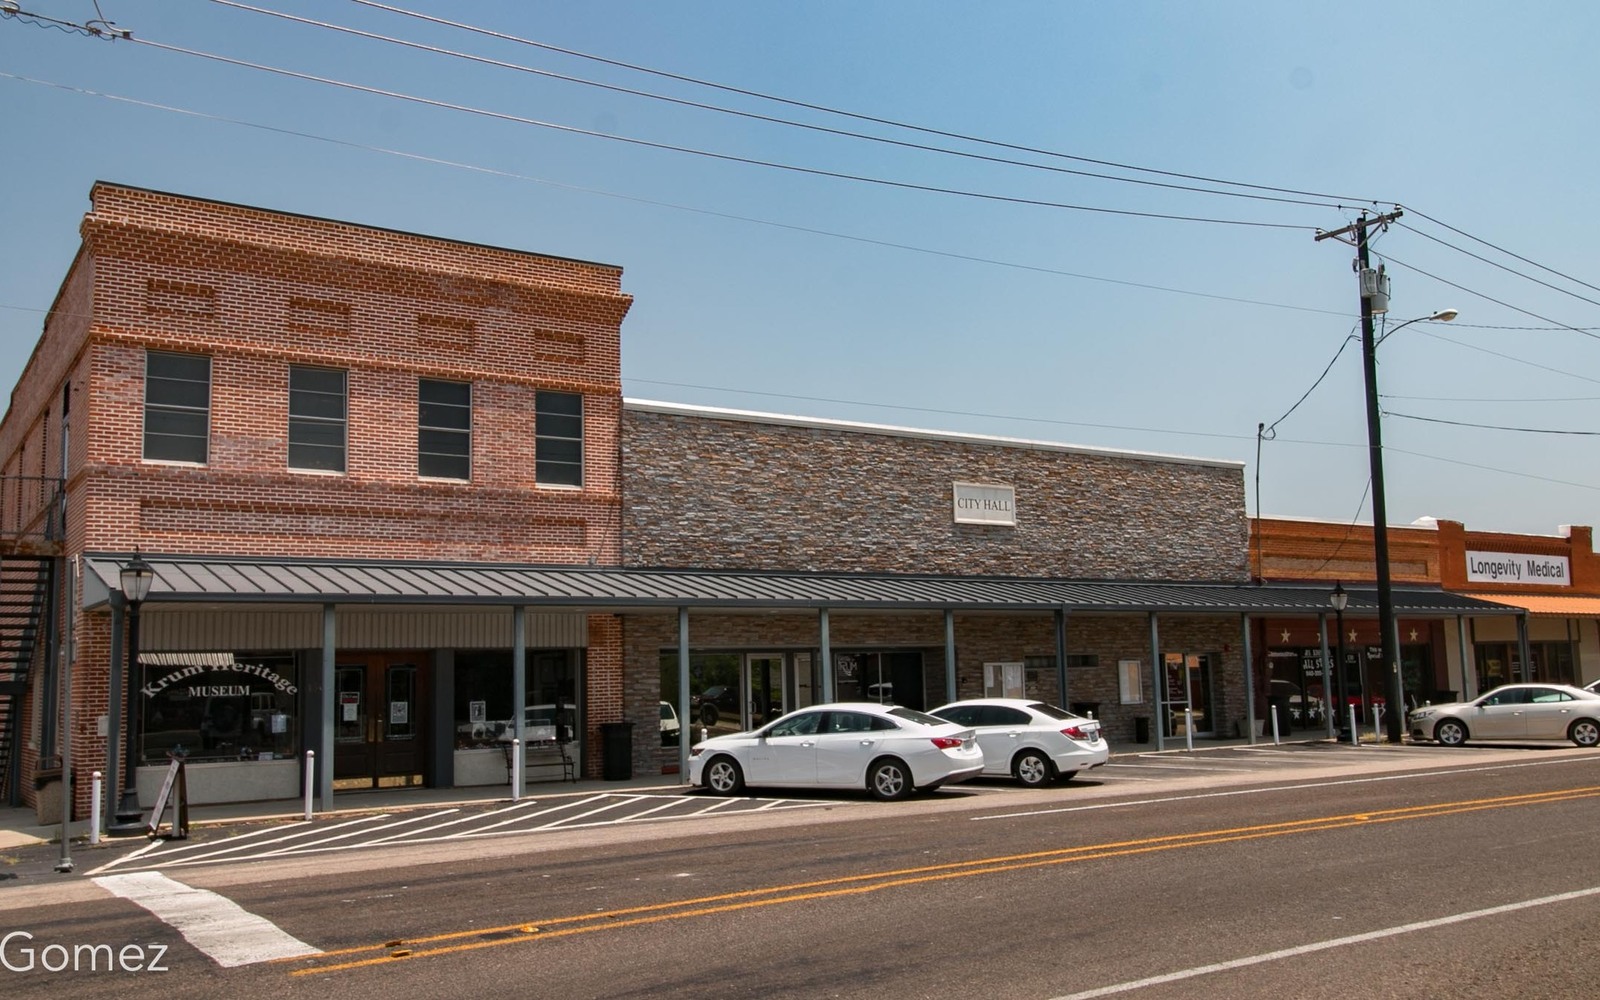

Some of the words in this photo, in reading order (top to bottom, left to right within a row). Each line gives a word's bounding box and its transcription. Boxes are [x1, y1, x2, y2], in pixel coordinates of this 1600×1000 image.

[957, 498, 979, 509] CITY
[984, 500, 1010, 511] HALL
[1470, 557, 1521, 580] Longevity
[1527, 560, 1564, 577] Medical
[140, 664, 204, 698] Krum
[188, 685, 250, 697] MUSEUM
